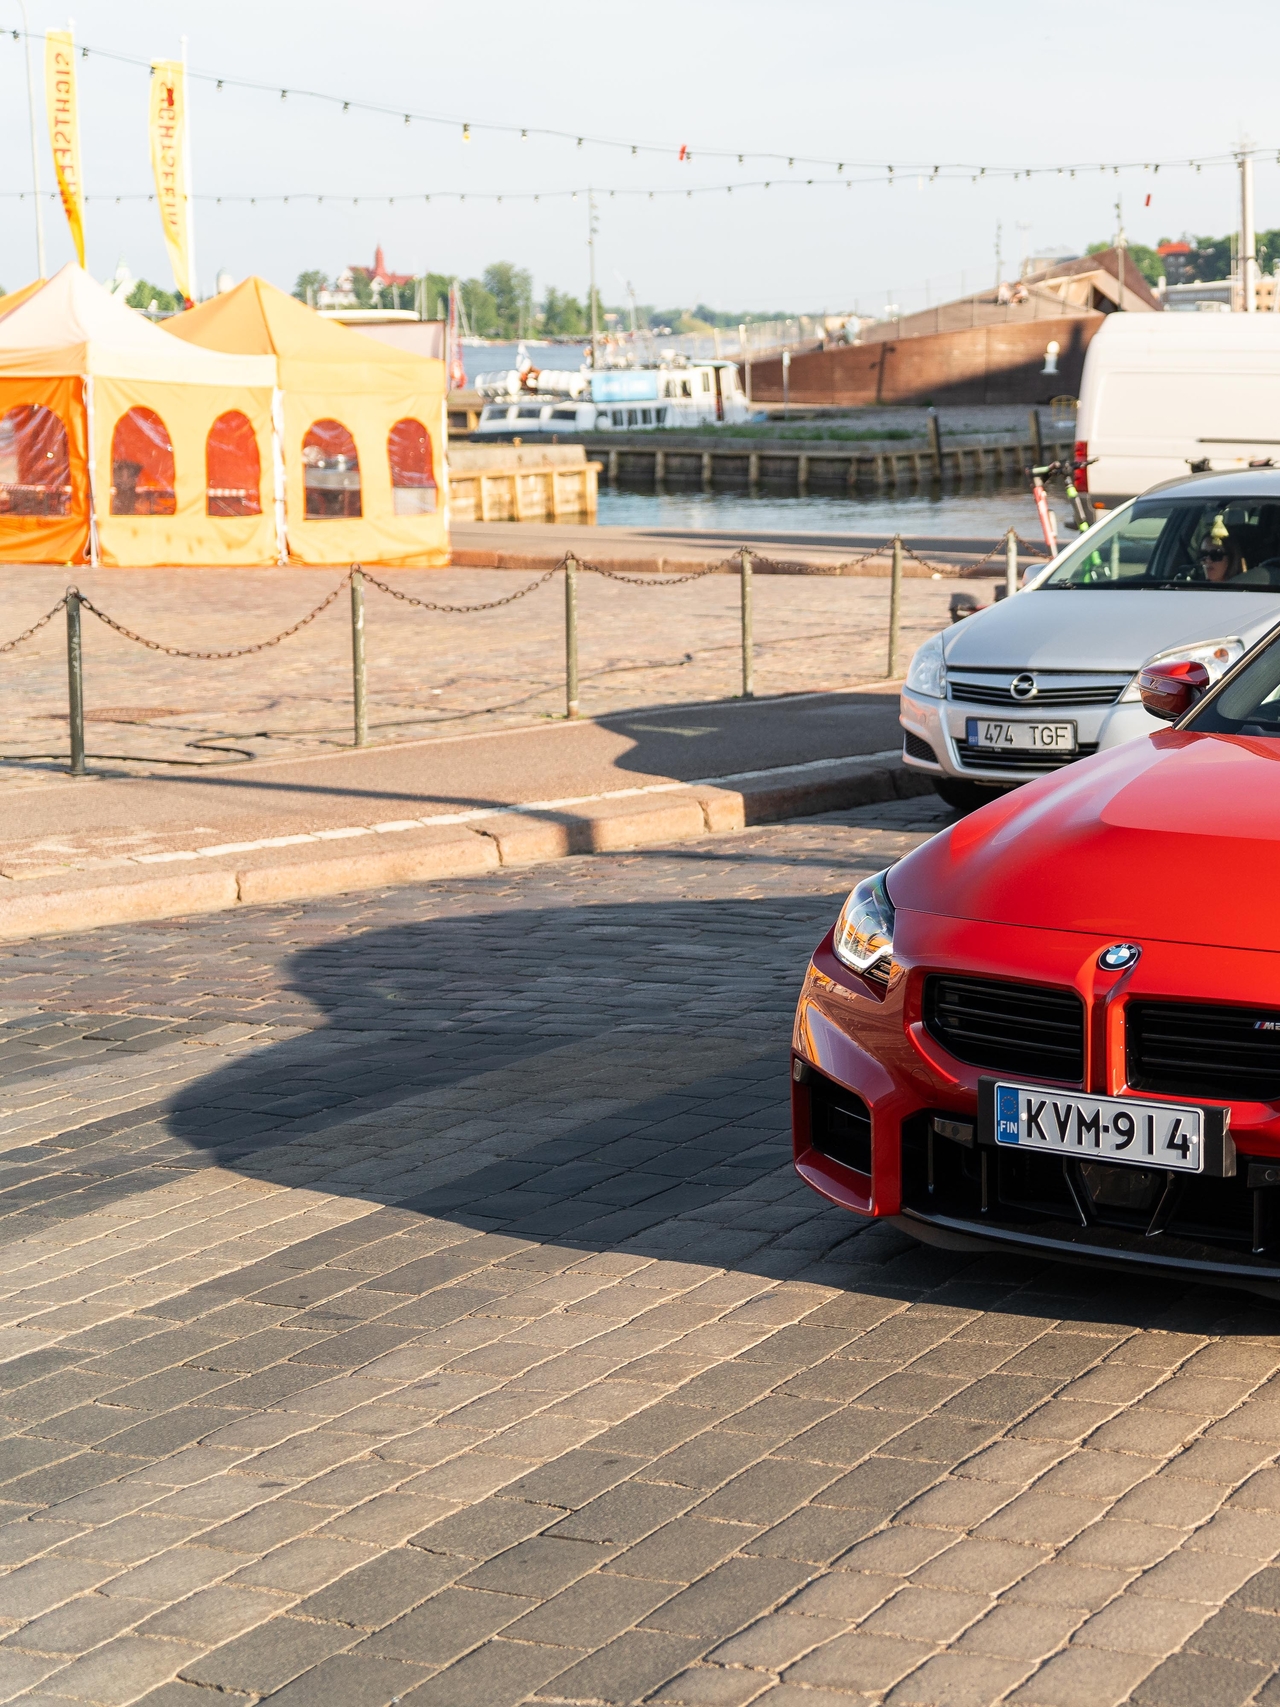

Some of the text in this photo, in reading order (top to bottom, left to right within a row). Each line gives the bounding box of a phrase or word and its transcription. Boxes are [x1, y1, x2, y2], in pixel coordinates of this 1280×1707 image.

[984, 723, 1068, 746] 474 TGF
[999, 1119, 1018, 1135] FIN
[1026, 1097, 1191, 1160] KVM-914
